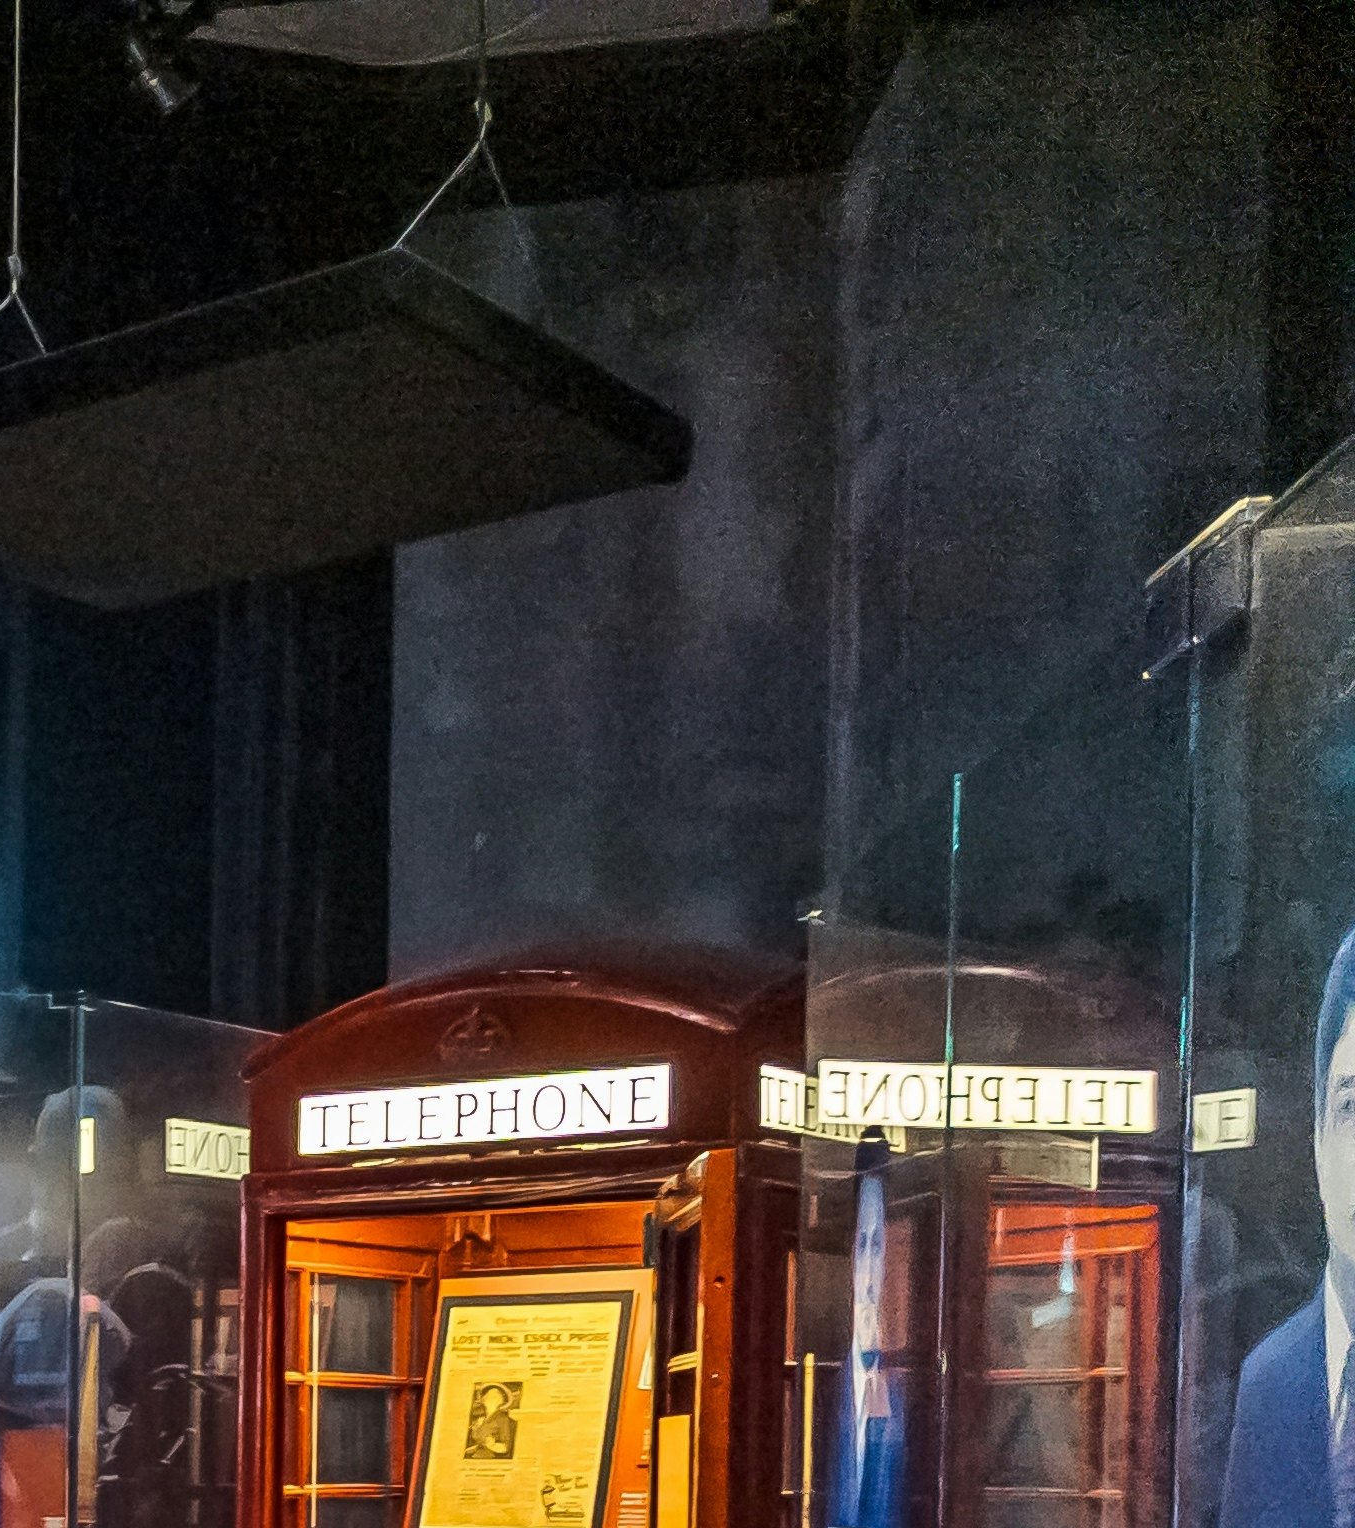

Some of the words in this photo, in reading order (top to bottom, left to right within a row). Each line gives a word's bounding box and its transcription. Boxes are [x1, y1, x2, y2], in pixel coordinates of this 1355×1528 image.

[309, 1075, 658, 1149] TELEPHONE
[452, 1335, 481, 1345] LOST
[523, 1333, 562, 1343] ESSEX
